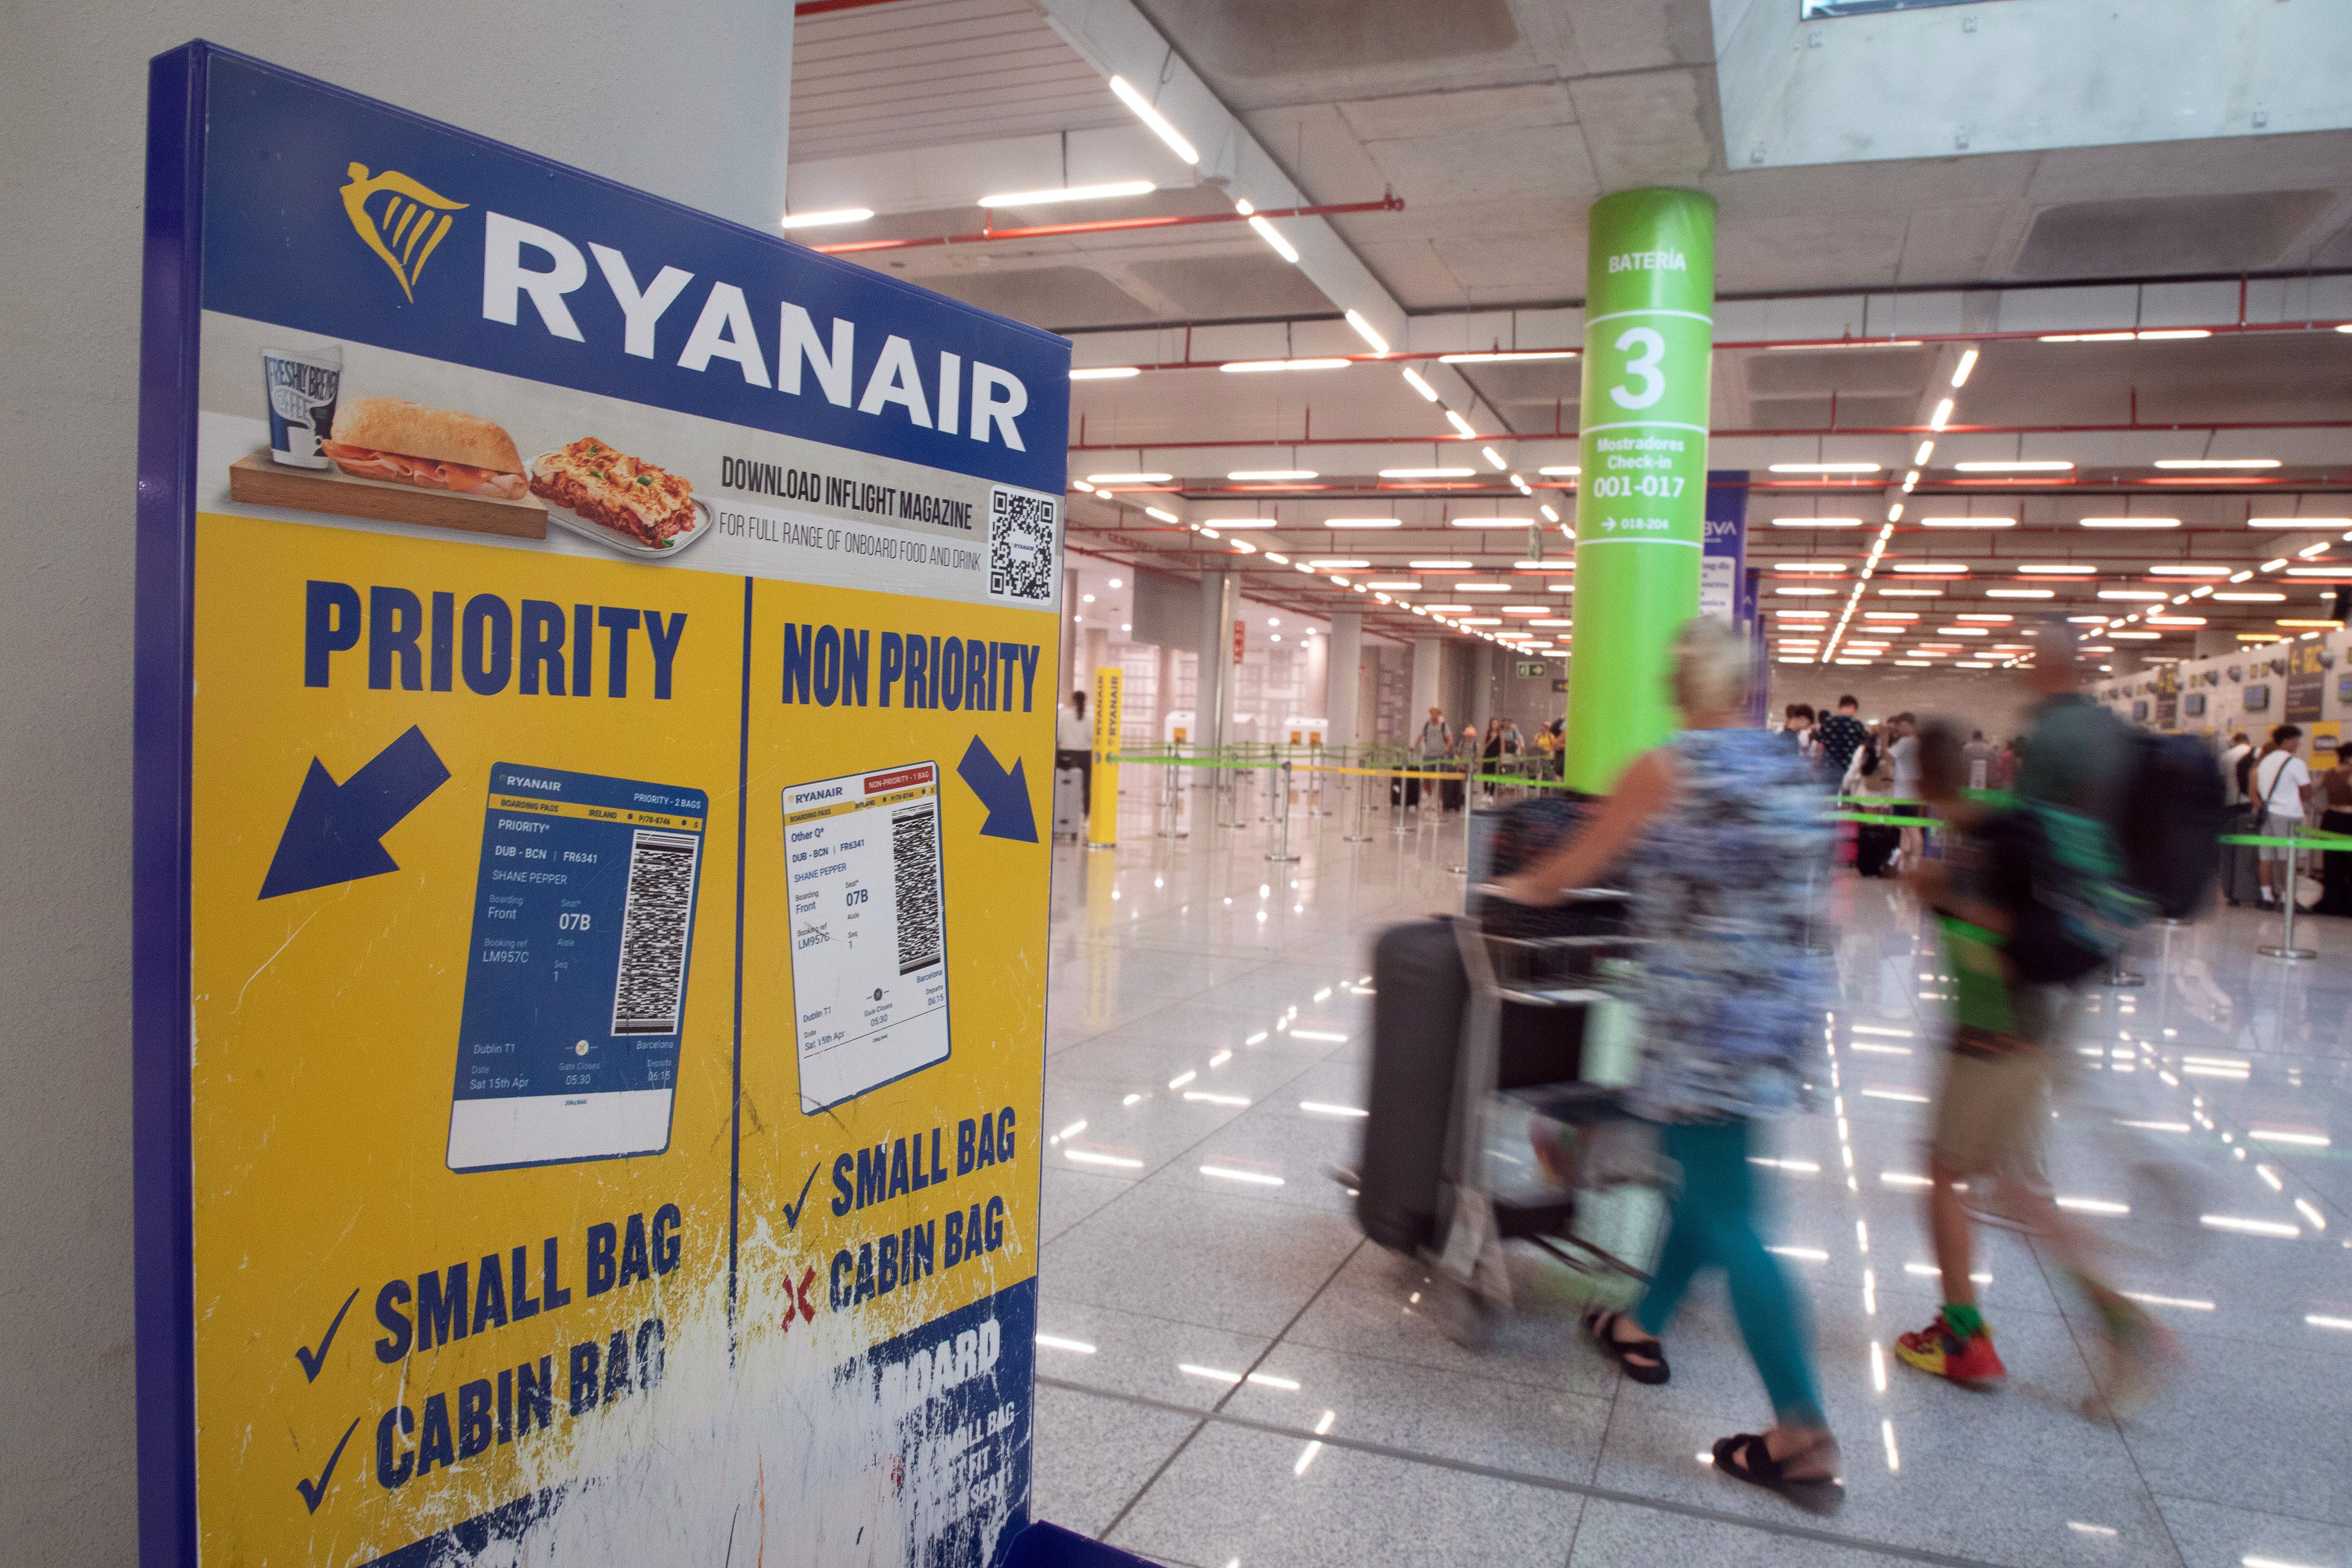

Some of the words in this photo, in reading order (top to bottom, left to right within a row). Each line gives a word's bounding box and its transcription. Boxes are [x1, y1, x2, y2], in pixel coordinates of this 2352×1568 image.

[1608, 249, 1686, 274] BATERÍA
[483, 210, 1029, 452] RYANAIR
[1609, 326, 1666, 410] 3
[1597, 438, 1684, 452] Mostradores
[1607, 453, 1672, 470] Check-in
[721, 456, 821, 503] DOWNLOAD
[826, 476, 896, 516] INFLIGHT
[900, 490, 972, 530] MAGAZINE
[1594, 475, 1685, 498] 001-017
[720, 512, 744, 537] FOR
[749, 517, 779, 542] FULL
[783, 522, 823, 549] RANGE
[827, 529, 841, 551] OF
[845, 532, 897, 559] ONBOARD
[900, 540, 927, 563] FOOD
[929, 546, 950, 567] AND
[953, 549, 981, 571] DRINK
[1013, 543, 1034, 551] RYANAIR
[304, 580, 687, 700] PRIORITY
[781, 623, 869, 708] NON
[880, 631, 1040, 713] PRIORITY
[1109, 676, 1118, 737] RYANAIR
[507, 775, 562, 792] RYANAIR
[633, 793, 669, 805] PRIORITY
[675, 798, 681, 807] 2
[681, 800, 701, 810] BAGS
[796, 787, 843, 804] RYANAIR
[500, 798, 538, 811] BOARDING
[540, 804, 559, 813] PASS
[589, 809, 617, 819] IRELAND
[790, 812, 817, 823] BOARDING
[791, 830, 813, 842] Other
[495, 845, 517, 857] DUB
[525, 847, 547, 860] BCN
[840, 839, 864, 852] FR6341
[563, 851, 597, 864] FR6341
[793, 852, 807, 863] DUB
[813, 847, 828, 858] BCN
[492, 870, 527, 882] SHANE
[529, 872, 567, 885] PEPPER
[794, 868, 819, 882] SHANE
[820, 863, 847, 877] PEPPER
[796, 890, 819, 902] Boarding
[846, 888, 868, 907] 07B
[487, 907, 517, 920] Front
[796, 901, 816, 914] Front
[559, 913, 591, 931] 07B
[483, 951, 529, 963] LM957C
[917, 970, 943, 984] Barcelona
[803, 1011, 823, 1023] Dublin
[823, 1007, 831, 1015] T1
[473, 1044, 502, 1055] Dublin
[504, 1043, 515, 1053] T1
[636, 1040, 674, 1049] Barcelona
[805, 1041, 816, 1051] Sat
[818, 1035, 832, 1047] 15th
[833, 1031, 845, 1042] Apr
[470, 1079, 486, 1090] Sat
[489, 1078, 509, 1088] 15th
[512, 1078, 529, 1091] Apr
[831, 1127, 948, 1218] SMALL
[958, 1106, 1016, 1176] BAG
[830, 1218, 934, 1313] CABIN
[944, 1195, 1003, 1270] BAG
[375, 1236, 572, 1365] SMALL
[587, 1203, 681, 1298] BAG
[376, 1355, 552, 1490] CABIN
[570, 1318, 666, 1417] BAG
[987, 1402, 1014, 1437] BAG
[969, 1445, 990, 1478] FIT
